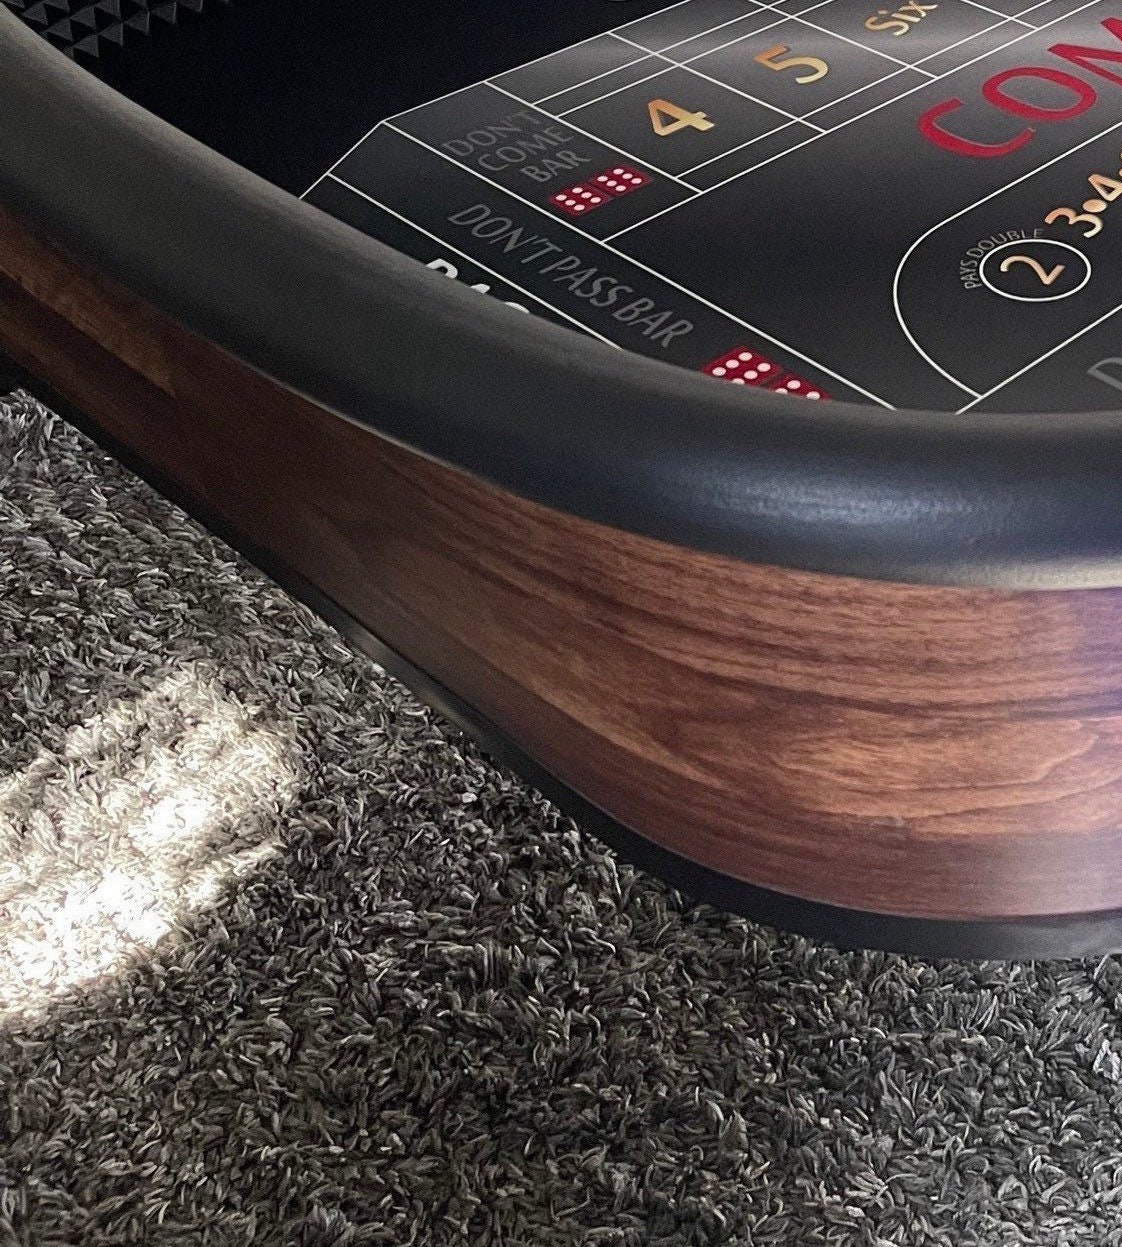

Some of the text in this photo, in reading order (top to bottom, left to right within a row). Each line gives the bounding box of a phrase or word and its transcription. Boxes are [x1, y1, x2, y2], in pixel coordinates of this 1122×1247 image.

[864, 0, 939, 37] Six
[754, 43, 829, 84] 5
[648, 98, 715, 137] 4
[478, 126, 574, 171] COME
[520, 150, 592, 182] BAR
[447, 204, 562, 265] DON'T
[540, 253, 622, 308] PASS
[612, 299, 694, 349] BAR
[959, 228, 1044, 289] PAYS DOUBLE
[1000, 254, 1065, 285] 2
